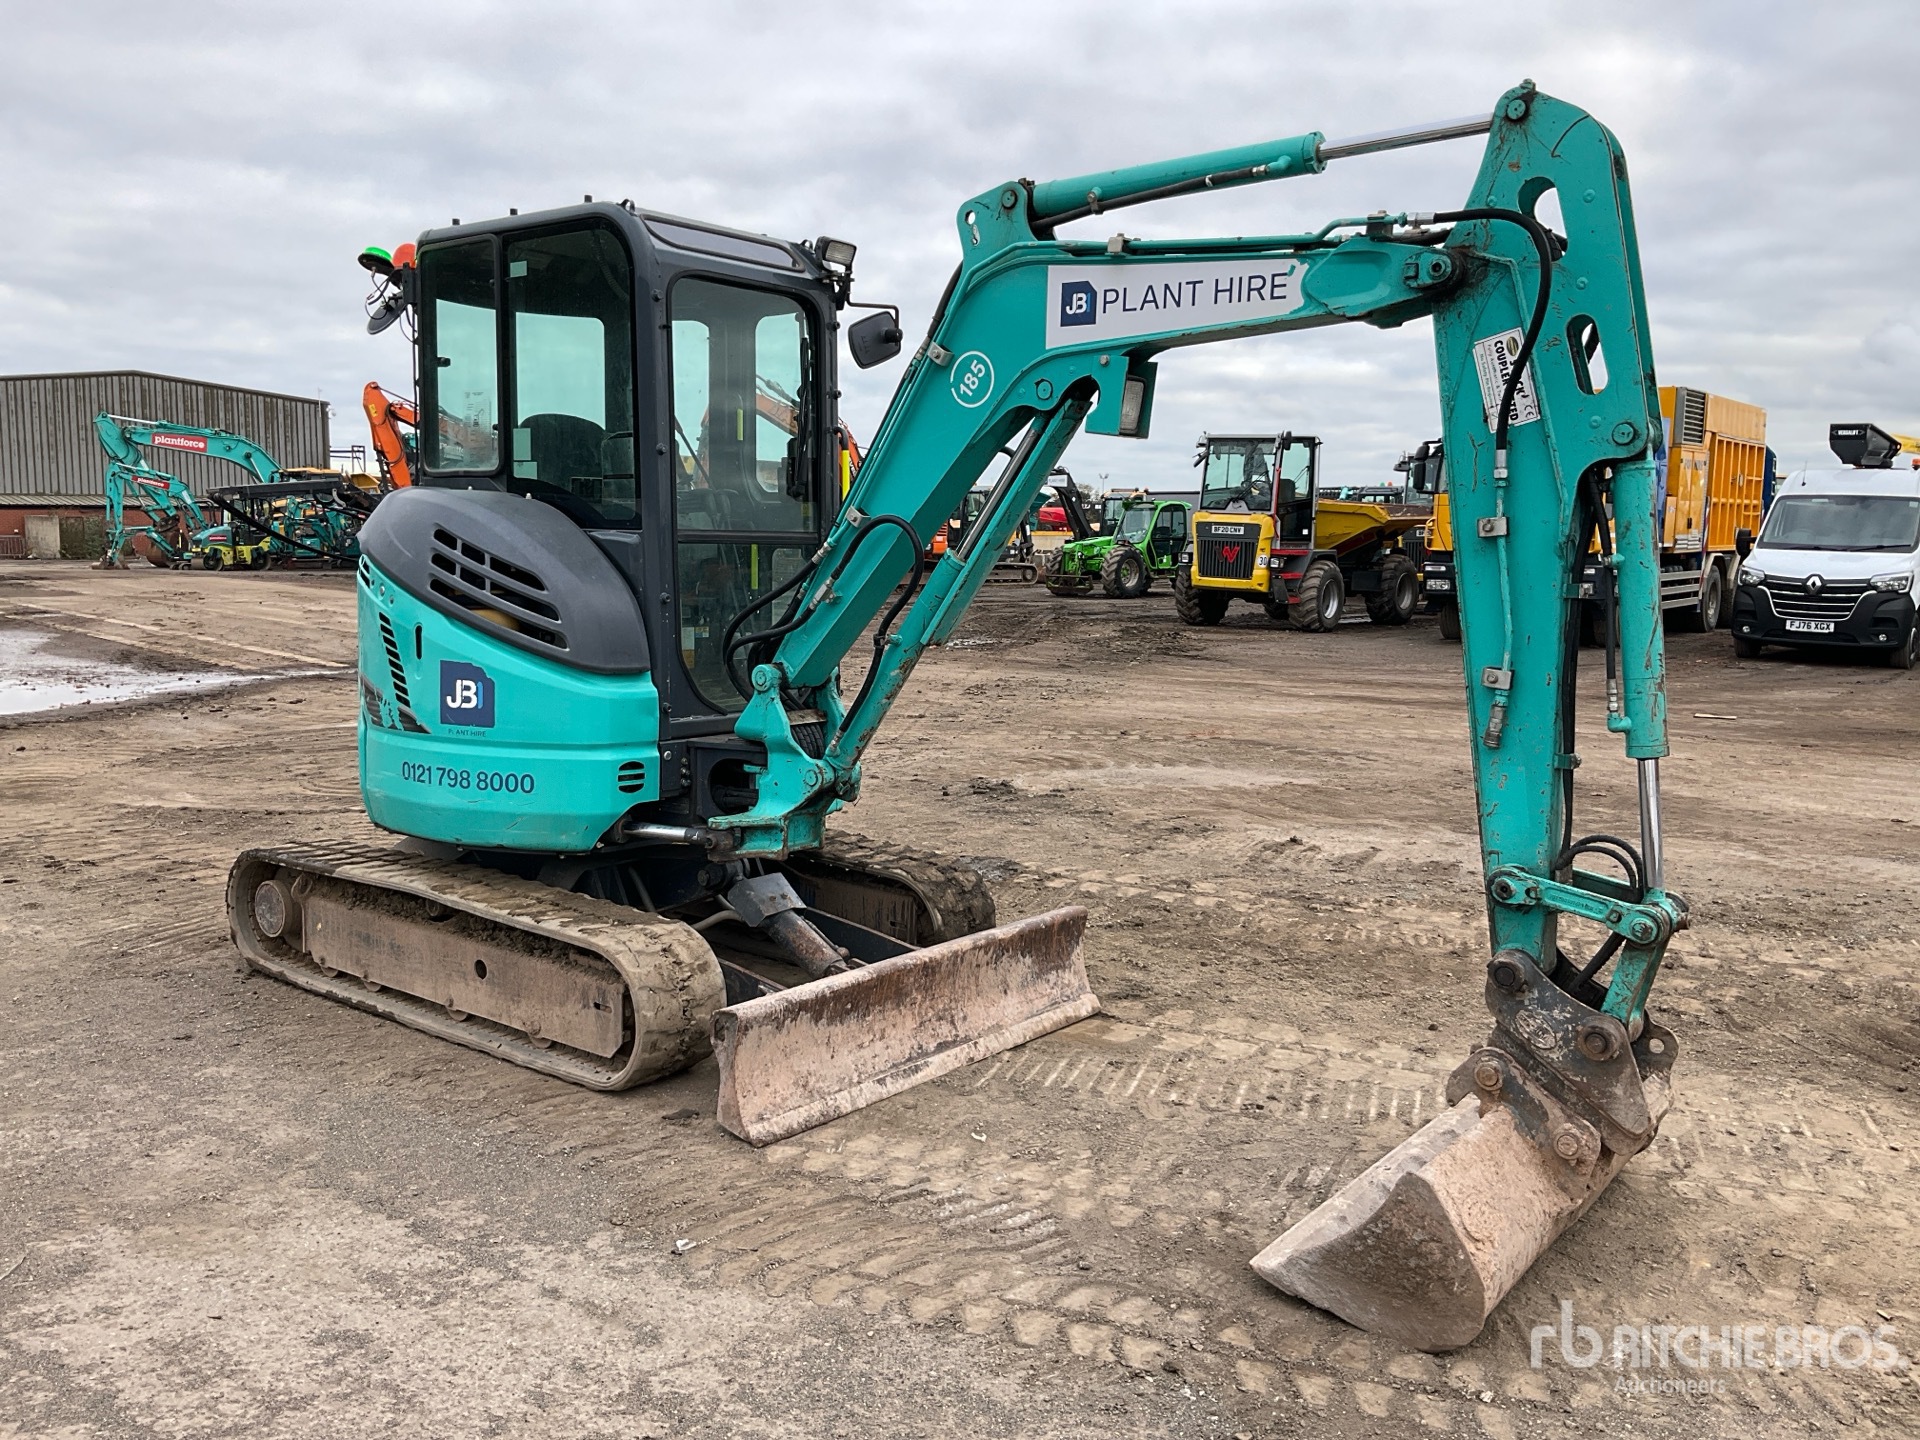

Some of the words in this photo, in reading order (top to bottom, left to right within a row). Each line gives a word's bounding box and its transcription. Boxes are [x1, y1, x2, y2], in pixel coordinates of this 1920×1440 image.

[1102, 280, 1204, 314] PLANT
[1213, 272, 1289, 304] HIRE
[960, 359, 985, 397] 185
[154, 435, 205, 449] plantforce
[1790, 620, 1812, 630] FJ76
[1813, 622, 1831, 631] XGX
[402, 761, 432, 785] 0121
[436, 767, 471, 790] 798
[476, 771, 535, 794] 8000
